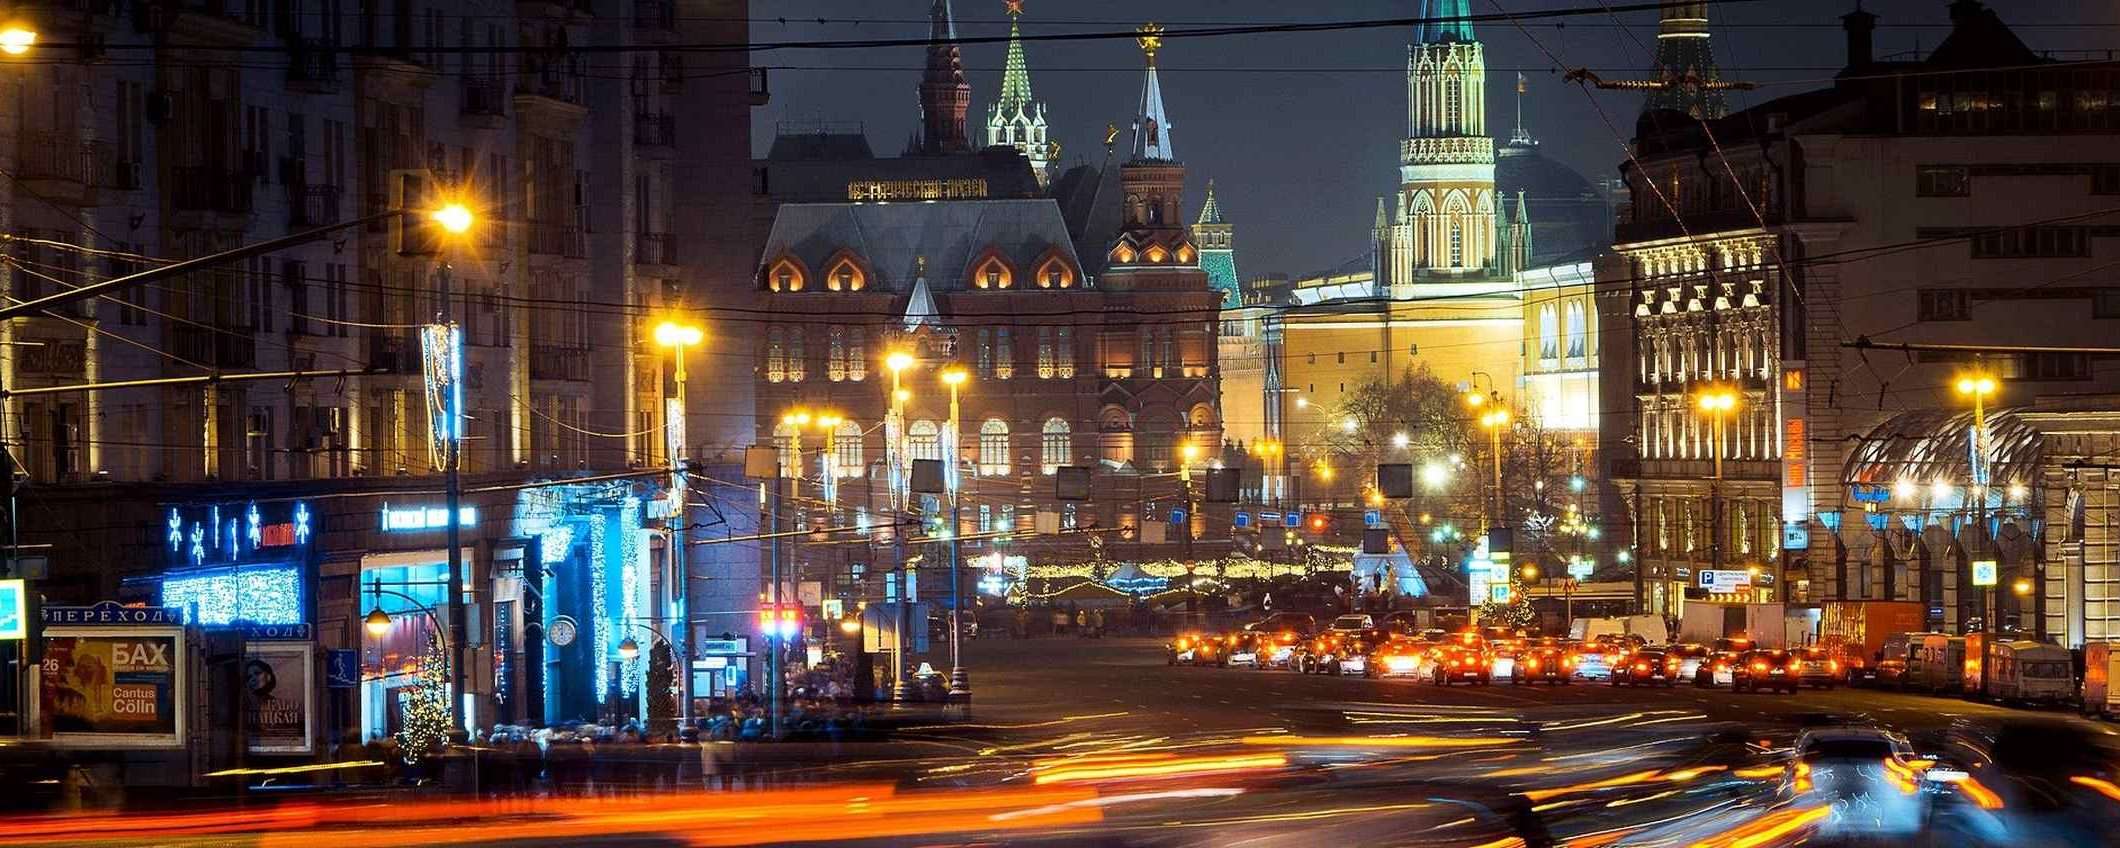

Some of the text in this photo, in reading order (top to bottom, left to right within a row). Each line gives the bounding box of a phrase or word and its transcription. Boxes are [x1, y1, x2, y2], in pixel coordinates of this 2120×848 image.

[53, 610, 162, 622] ПЕРЕХОД
[112, 642, 168, 665] БАХ
[42, 658, 59, 671] 26
[113, 687, 155, 698] Cantus
[113, 699, 155, 713] Cölln
